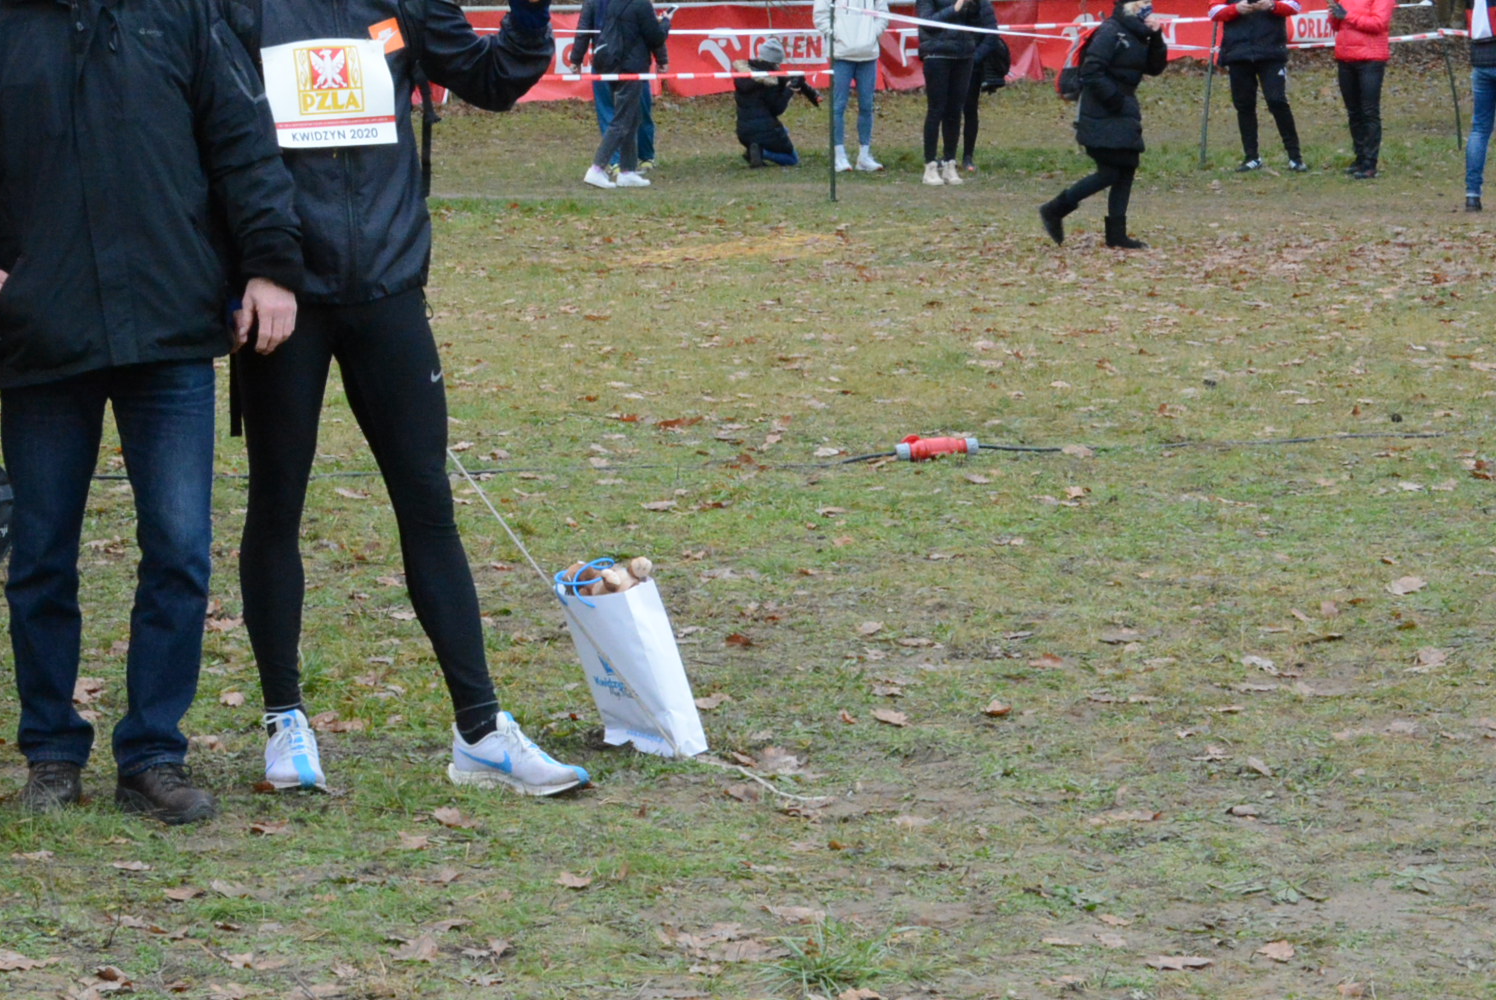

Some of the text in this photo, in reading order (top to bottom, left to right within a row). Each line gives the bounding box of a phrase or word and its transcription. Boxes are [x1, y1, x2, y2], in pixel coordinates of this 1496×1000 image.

[303, 90, 361, 111] PZLA
[291, 127, 379, 142] KWIDZYN 2020
